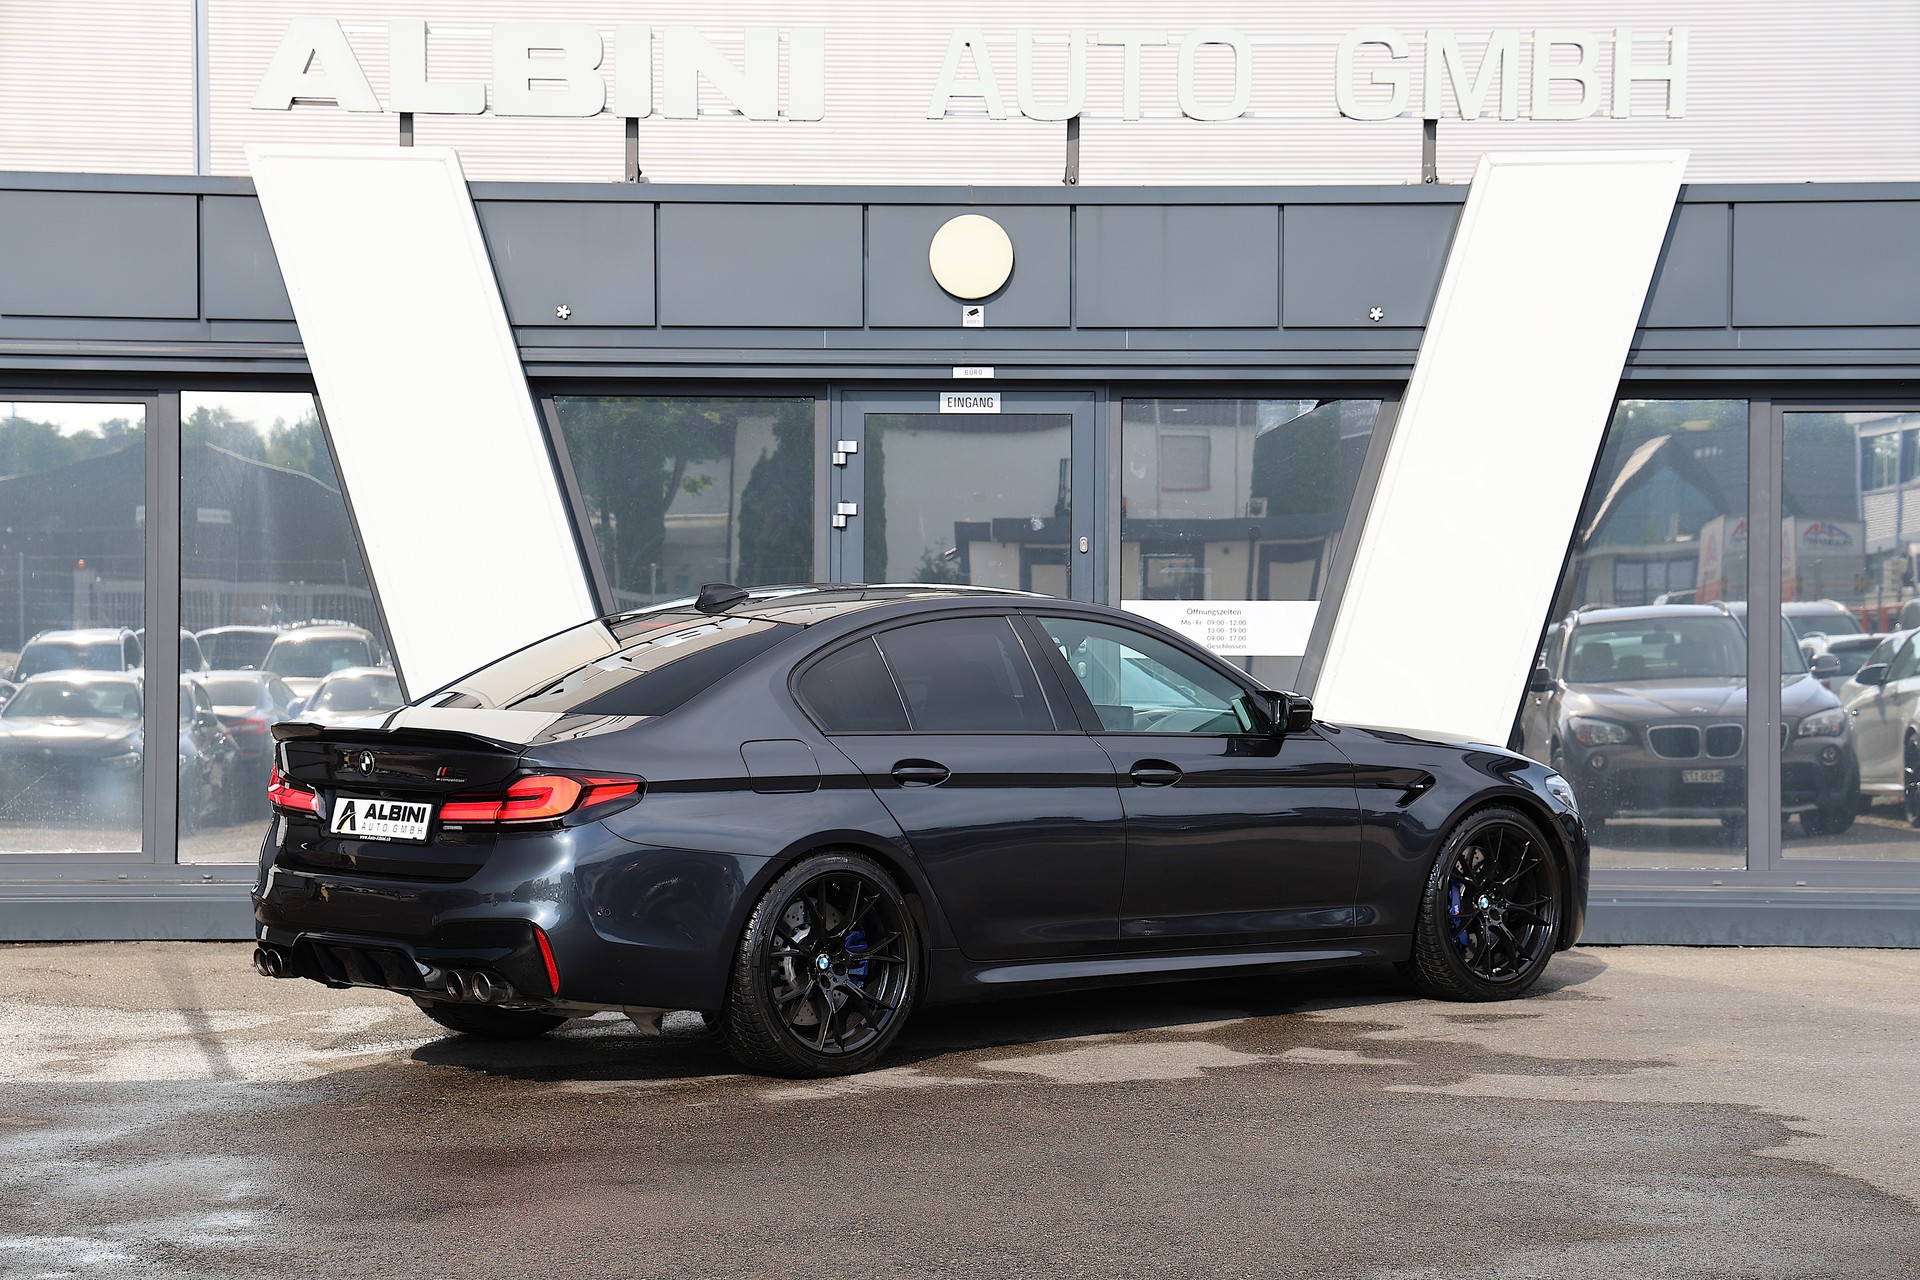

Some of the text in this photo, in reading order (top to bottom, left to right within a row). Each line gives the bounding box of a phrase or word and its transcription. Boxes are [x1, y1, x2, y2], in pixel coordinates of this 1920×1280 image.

[250, 16, 1689, 122] ALBINI AUTO GMBH
[964, 368, 983, 376] BÜRO
[947, 397, 994, 408] EINGANG
[1186, 607, 1242, 616] Öffnungszeiten
[364, 803, 427, 823] ALBINI
[361, 822, 423, 835] AUTO GMBH
